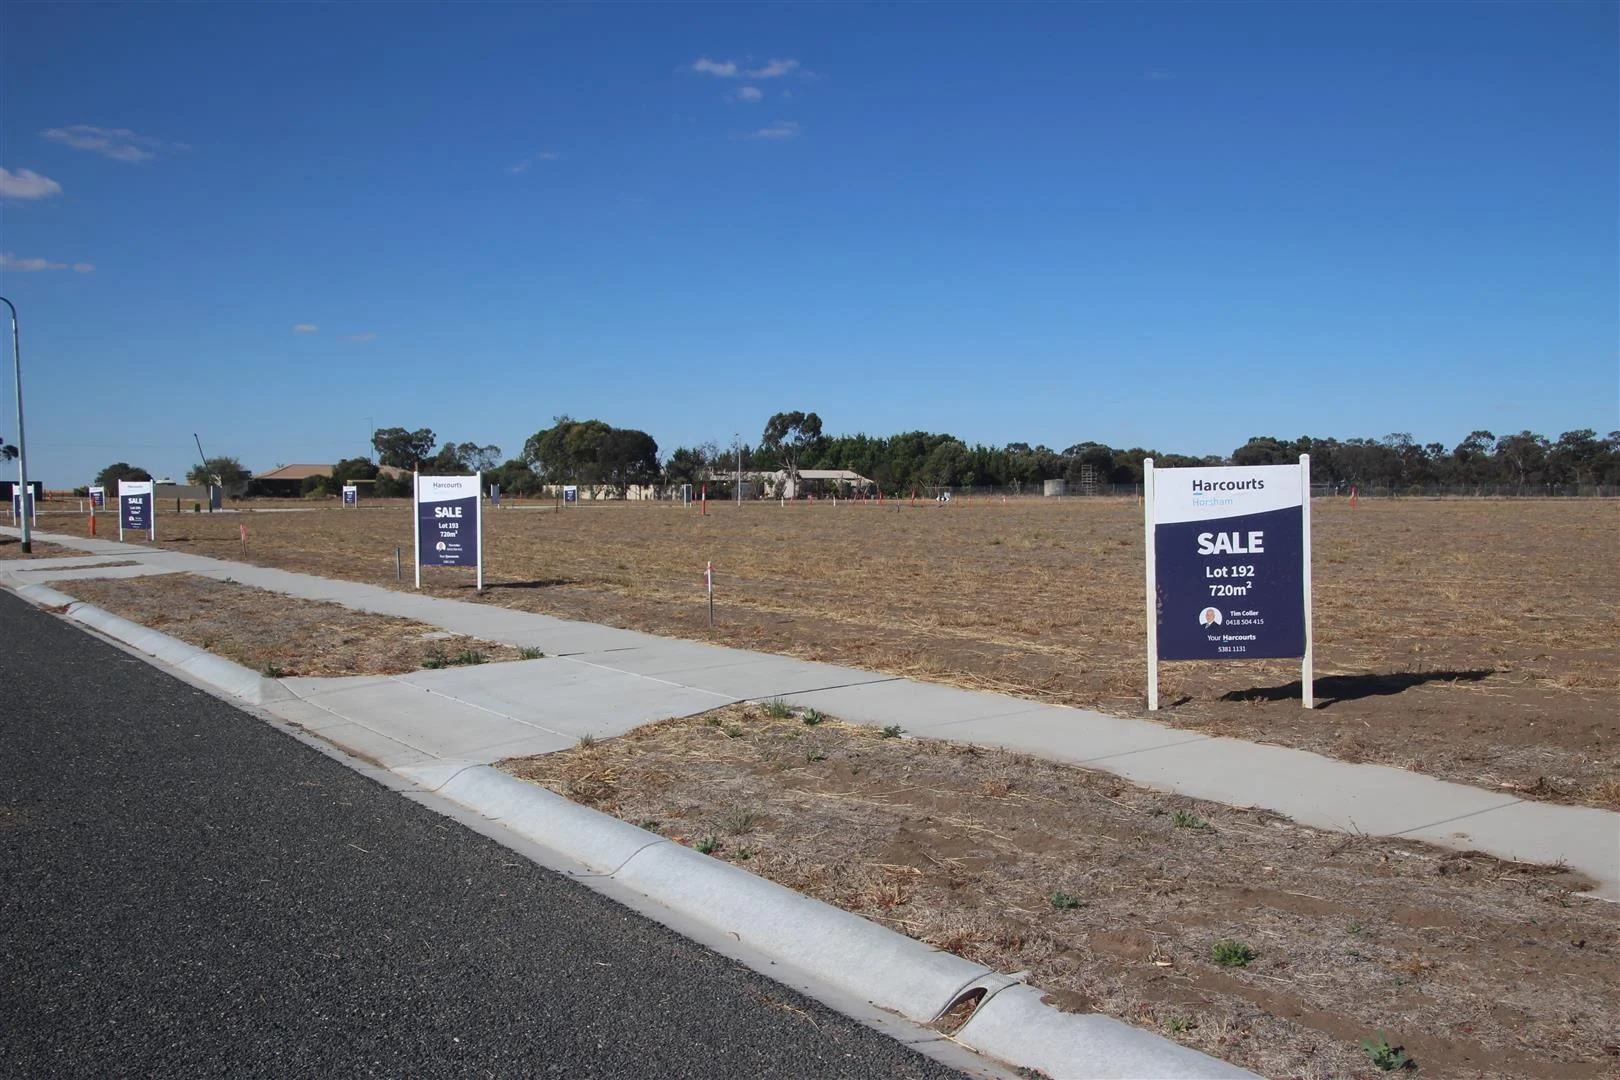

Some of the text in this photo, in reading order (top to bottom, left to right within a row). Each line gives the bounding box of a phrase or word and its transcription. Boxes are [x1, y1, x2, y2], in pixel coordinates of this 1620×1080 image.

[1192, 479, 1265, 492] Harcourts
[128, 497, 143, 505] SALE
[1192, 498, 1233, 507] Horsham
[434, 506, 463, 518] SALE
[1197, 531, 1265, 555] SALE
[1206, 565, 1255, 578] Lot 192
[1209, 581, 1252, 596] 720m²
